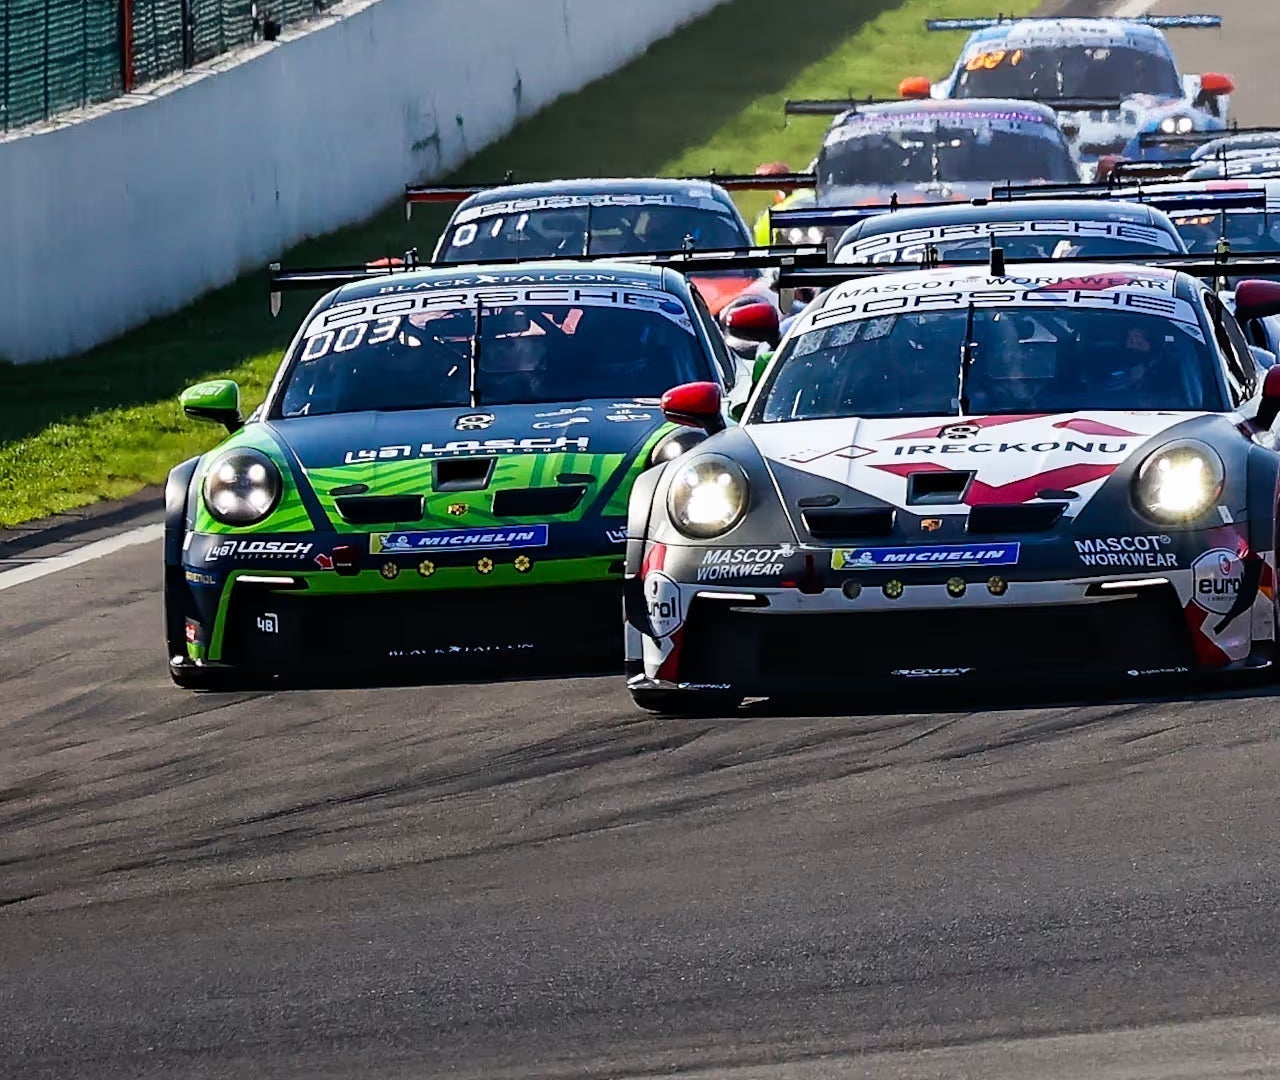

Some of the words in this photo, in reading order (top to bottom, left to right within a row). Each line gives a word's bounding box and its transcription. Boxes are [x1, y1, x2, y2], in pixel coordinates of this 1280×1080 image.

[853, 221, 1158, 256] PORSCHE
[380, 278, 471, 294] BLACK
[502, 273, 616, 285] FALCON
[837, 279, 964, 301] MASCOT
[986, 274, 1168, 291] WORKWEAR
[323, 288, 669, 328] PORSCHE
[811, 290, 1176, 326] PORSCHE
[300, 315, 401, 363] 003
[420, 436, 590, 453] LOSCH
[894, 441, 1127, 456] IRECKONU
[237, 541, 313, 554] LOSCH
[418, 531, 535, 546] MICHELIN
[1074, 535, 1161, 554] MASCOT
[702, 549, 781, 565] MASCOT
[882, 549, 1006, 563] MICHELIN
[1079, 553, 1179, 567] WORKWEAR
[696, 564, 784, 581] WORKWEAR
[1199, 577, 1243, 595] euro
[649, 597, 677, 618] rol
